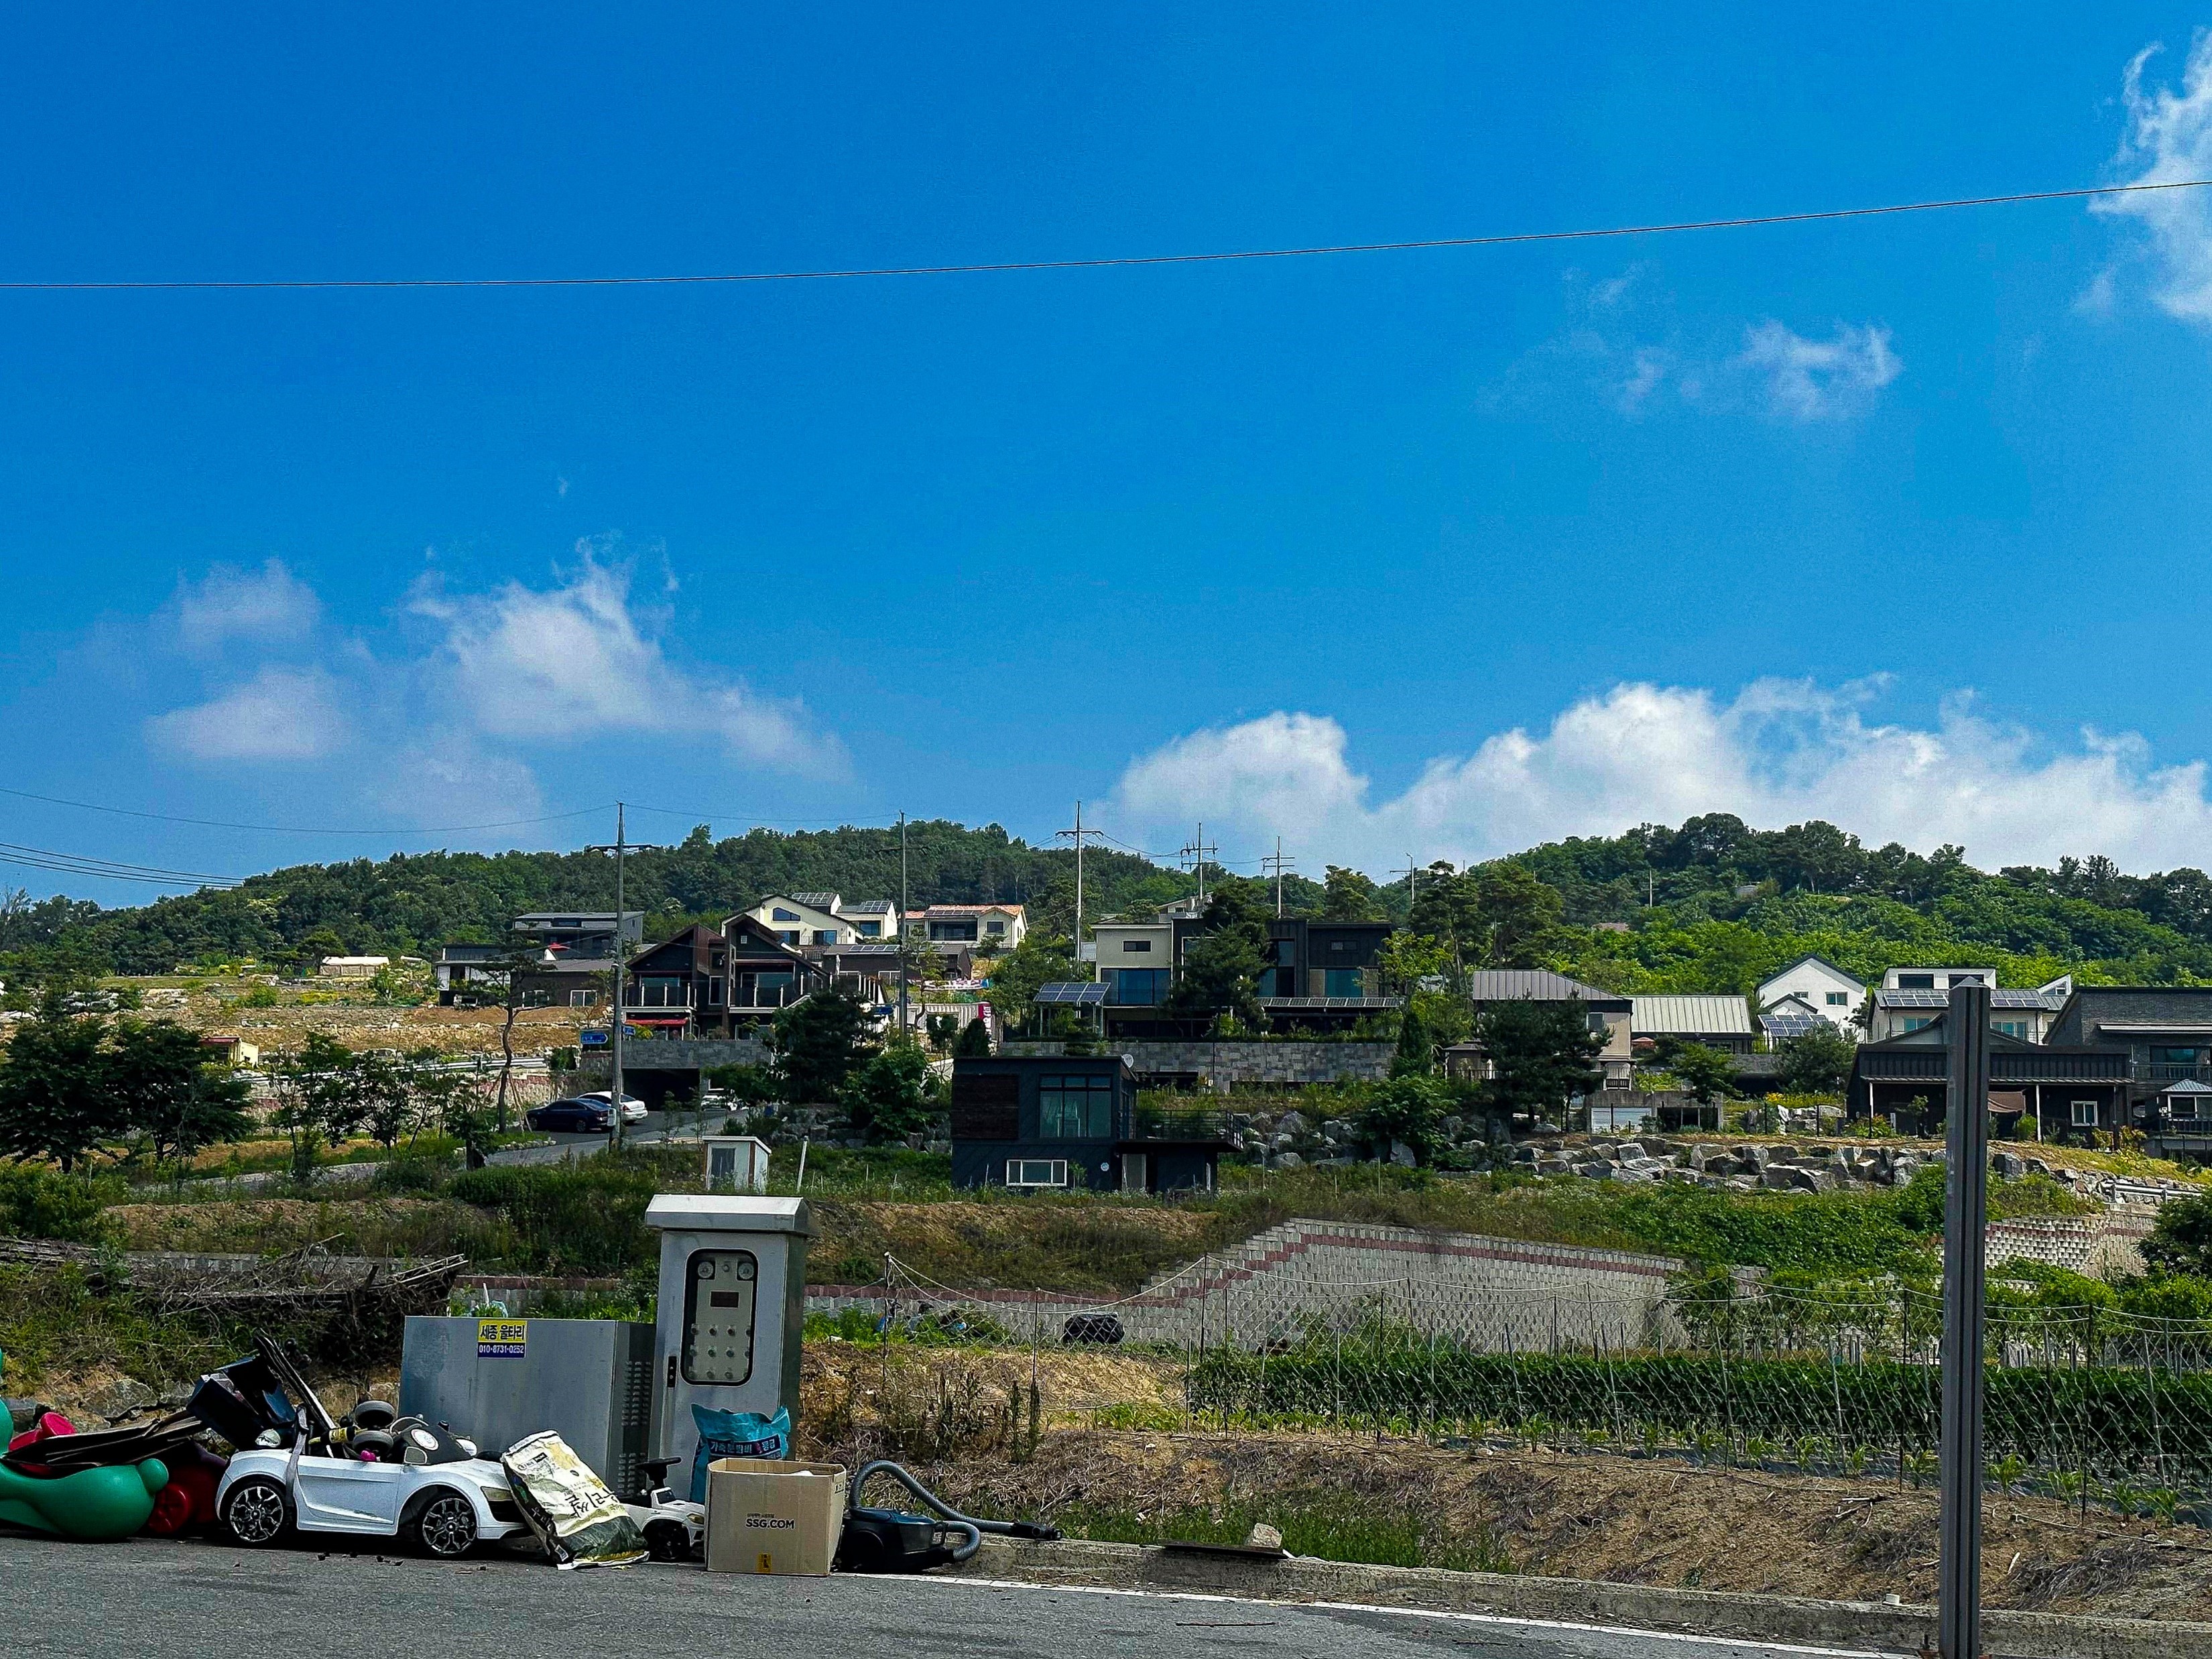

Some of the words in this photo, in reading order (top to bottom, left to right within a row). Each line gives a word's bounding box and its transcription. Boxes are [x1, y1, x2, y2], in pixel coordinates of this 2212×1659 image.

[480, 1325, 497, 1340] 세종
[500, 1325, 524, 1340] 울타리
[745, 1518, 795, 1529] SSG.COM
